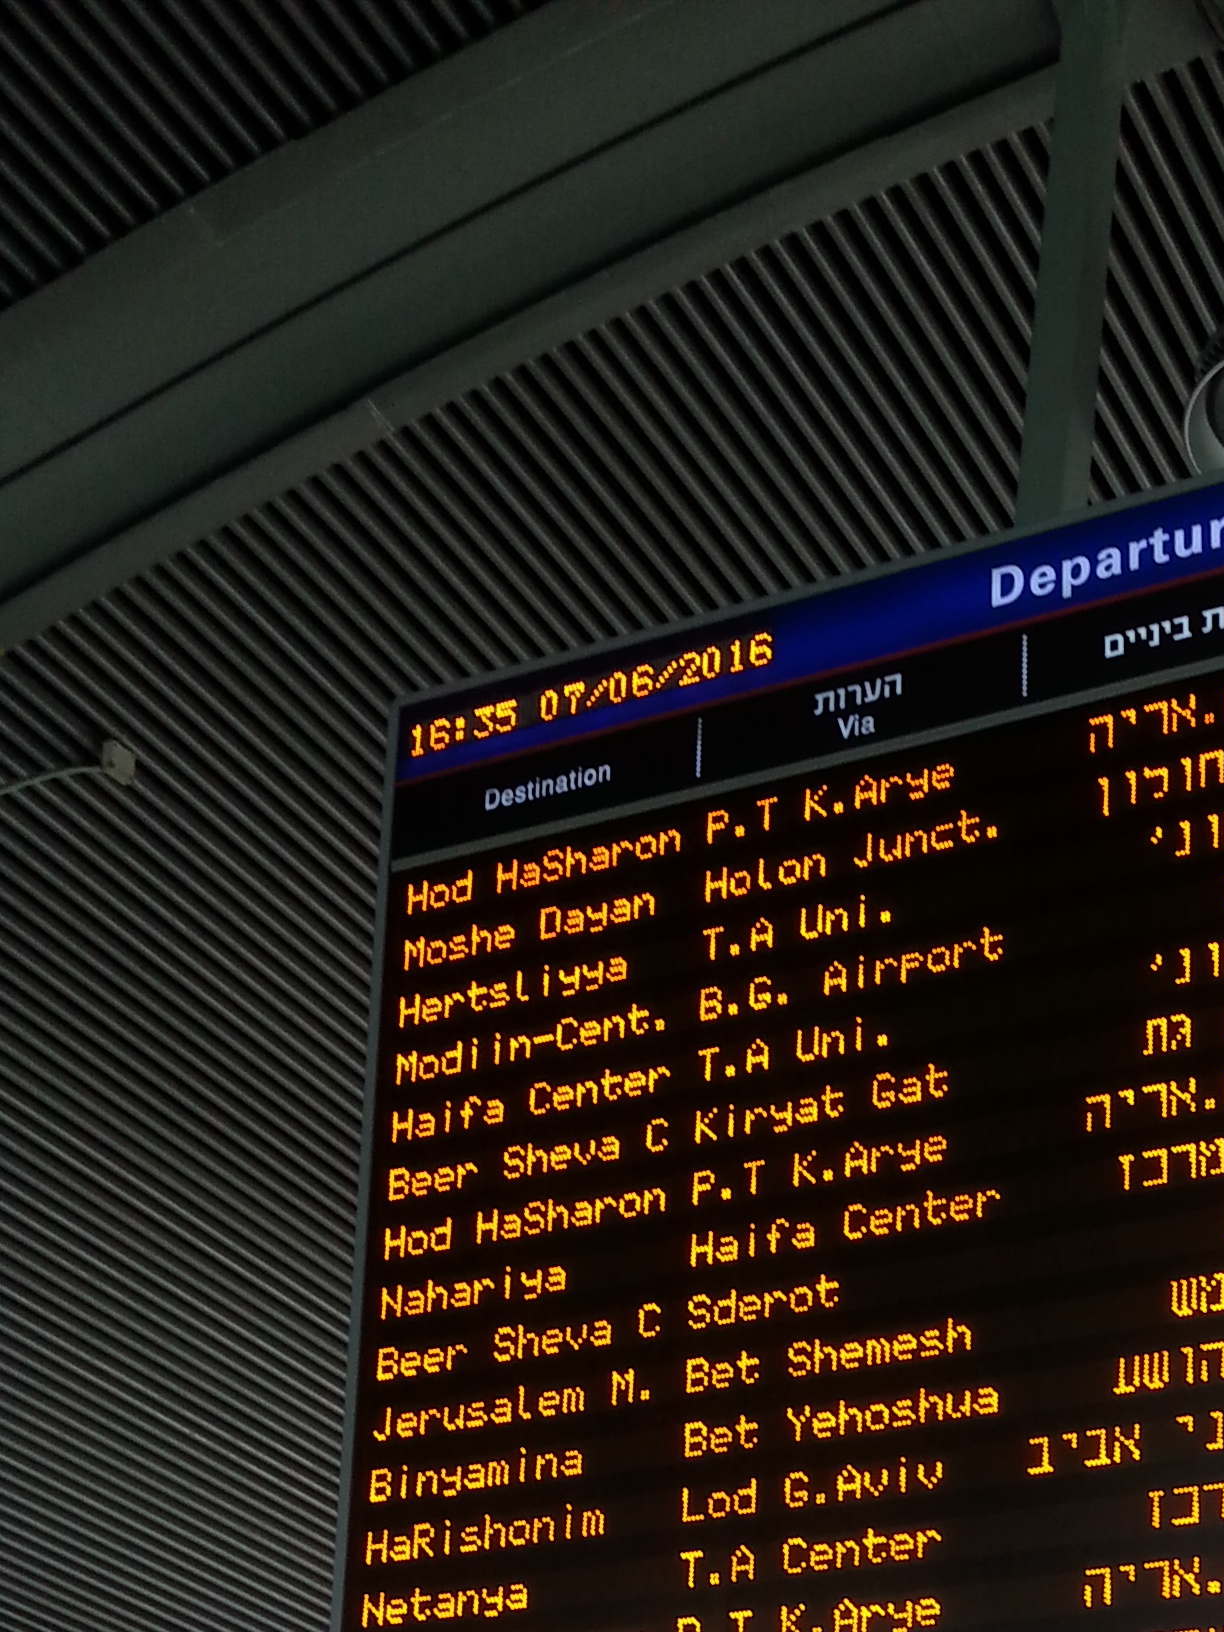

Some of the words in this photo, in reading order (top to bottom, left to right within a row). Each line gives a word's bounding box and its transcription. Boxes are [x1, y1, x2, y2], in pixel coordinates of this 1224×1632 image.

[1103, 613, 1193, 659] ביניים
[409, 698, 518, 758] 16:35
[538, 631, 774, 722] 07/06/2016
[813, 672, 903, 717] הערות
[836, 711, 876, 741] Via
[484, 763, 612, 811] Destination
[405, 868, 475, 917] Hod
[495, 827, 683, 895] HaSharon
[703, 852, 828, 905] Holon
[402, 922, 517, 973] Moshe
[538, 891, 657, 942] Dayan
[822, 925, 1005, 998] Airport
[397, 955, 629, 1030] Hertsliyya
[1141, 1012, 1193, 1057] גת
[390, 1094, 506, 1145] Haifa
[527, 1064, 672, 1117] Center
[693, 1083, 846, 1146] Kiryat
[870, 1062, 950, 1111] Gat
[386, 1160, 480, 1203] Beer
[502, 1134, 622, 1181] Sheva
[644, 1116, 670, 1154] C
[382, 1215, 454, 1262] Hod
[474, 1186, 667, 1246] HaSharon
[688, 1216, 817, 1269] Haifa
[841, 1188, 1002, 1242] Center
[379, 1264, 568, 1322] Nahariya
[686, 1272, 841, 1331] Sderot
[374, 1342, 469, 1383] Beer
[491, 1318, 613, 1364] Sheva
[636, 1301, 663, 1340] C
[684, 1349, 761, 1395] Bet
[786, 1316, 973, 1379] Shemesh
[371, 1384, 586, 1443] Jerusalem
[682, 1413, 760, 1460] Bet
[785, 1385, 1000, 1443] Yehoshua
[367, 1446, 584, 1505] Binyamina
[1025, 1422, 1142, 1477] אביב
[680, 1476, 759, 1524] Lod
[364, 1502, 606, 1567] HaRishonim
[780, 1526, 943, 1575] Center
[360, 1582, 529, 1630] Netanya
